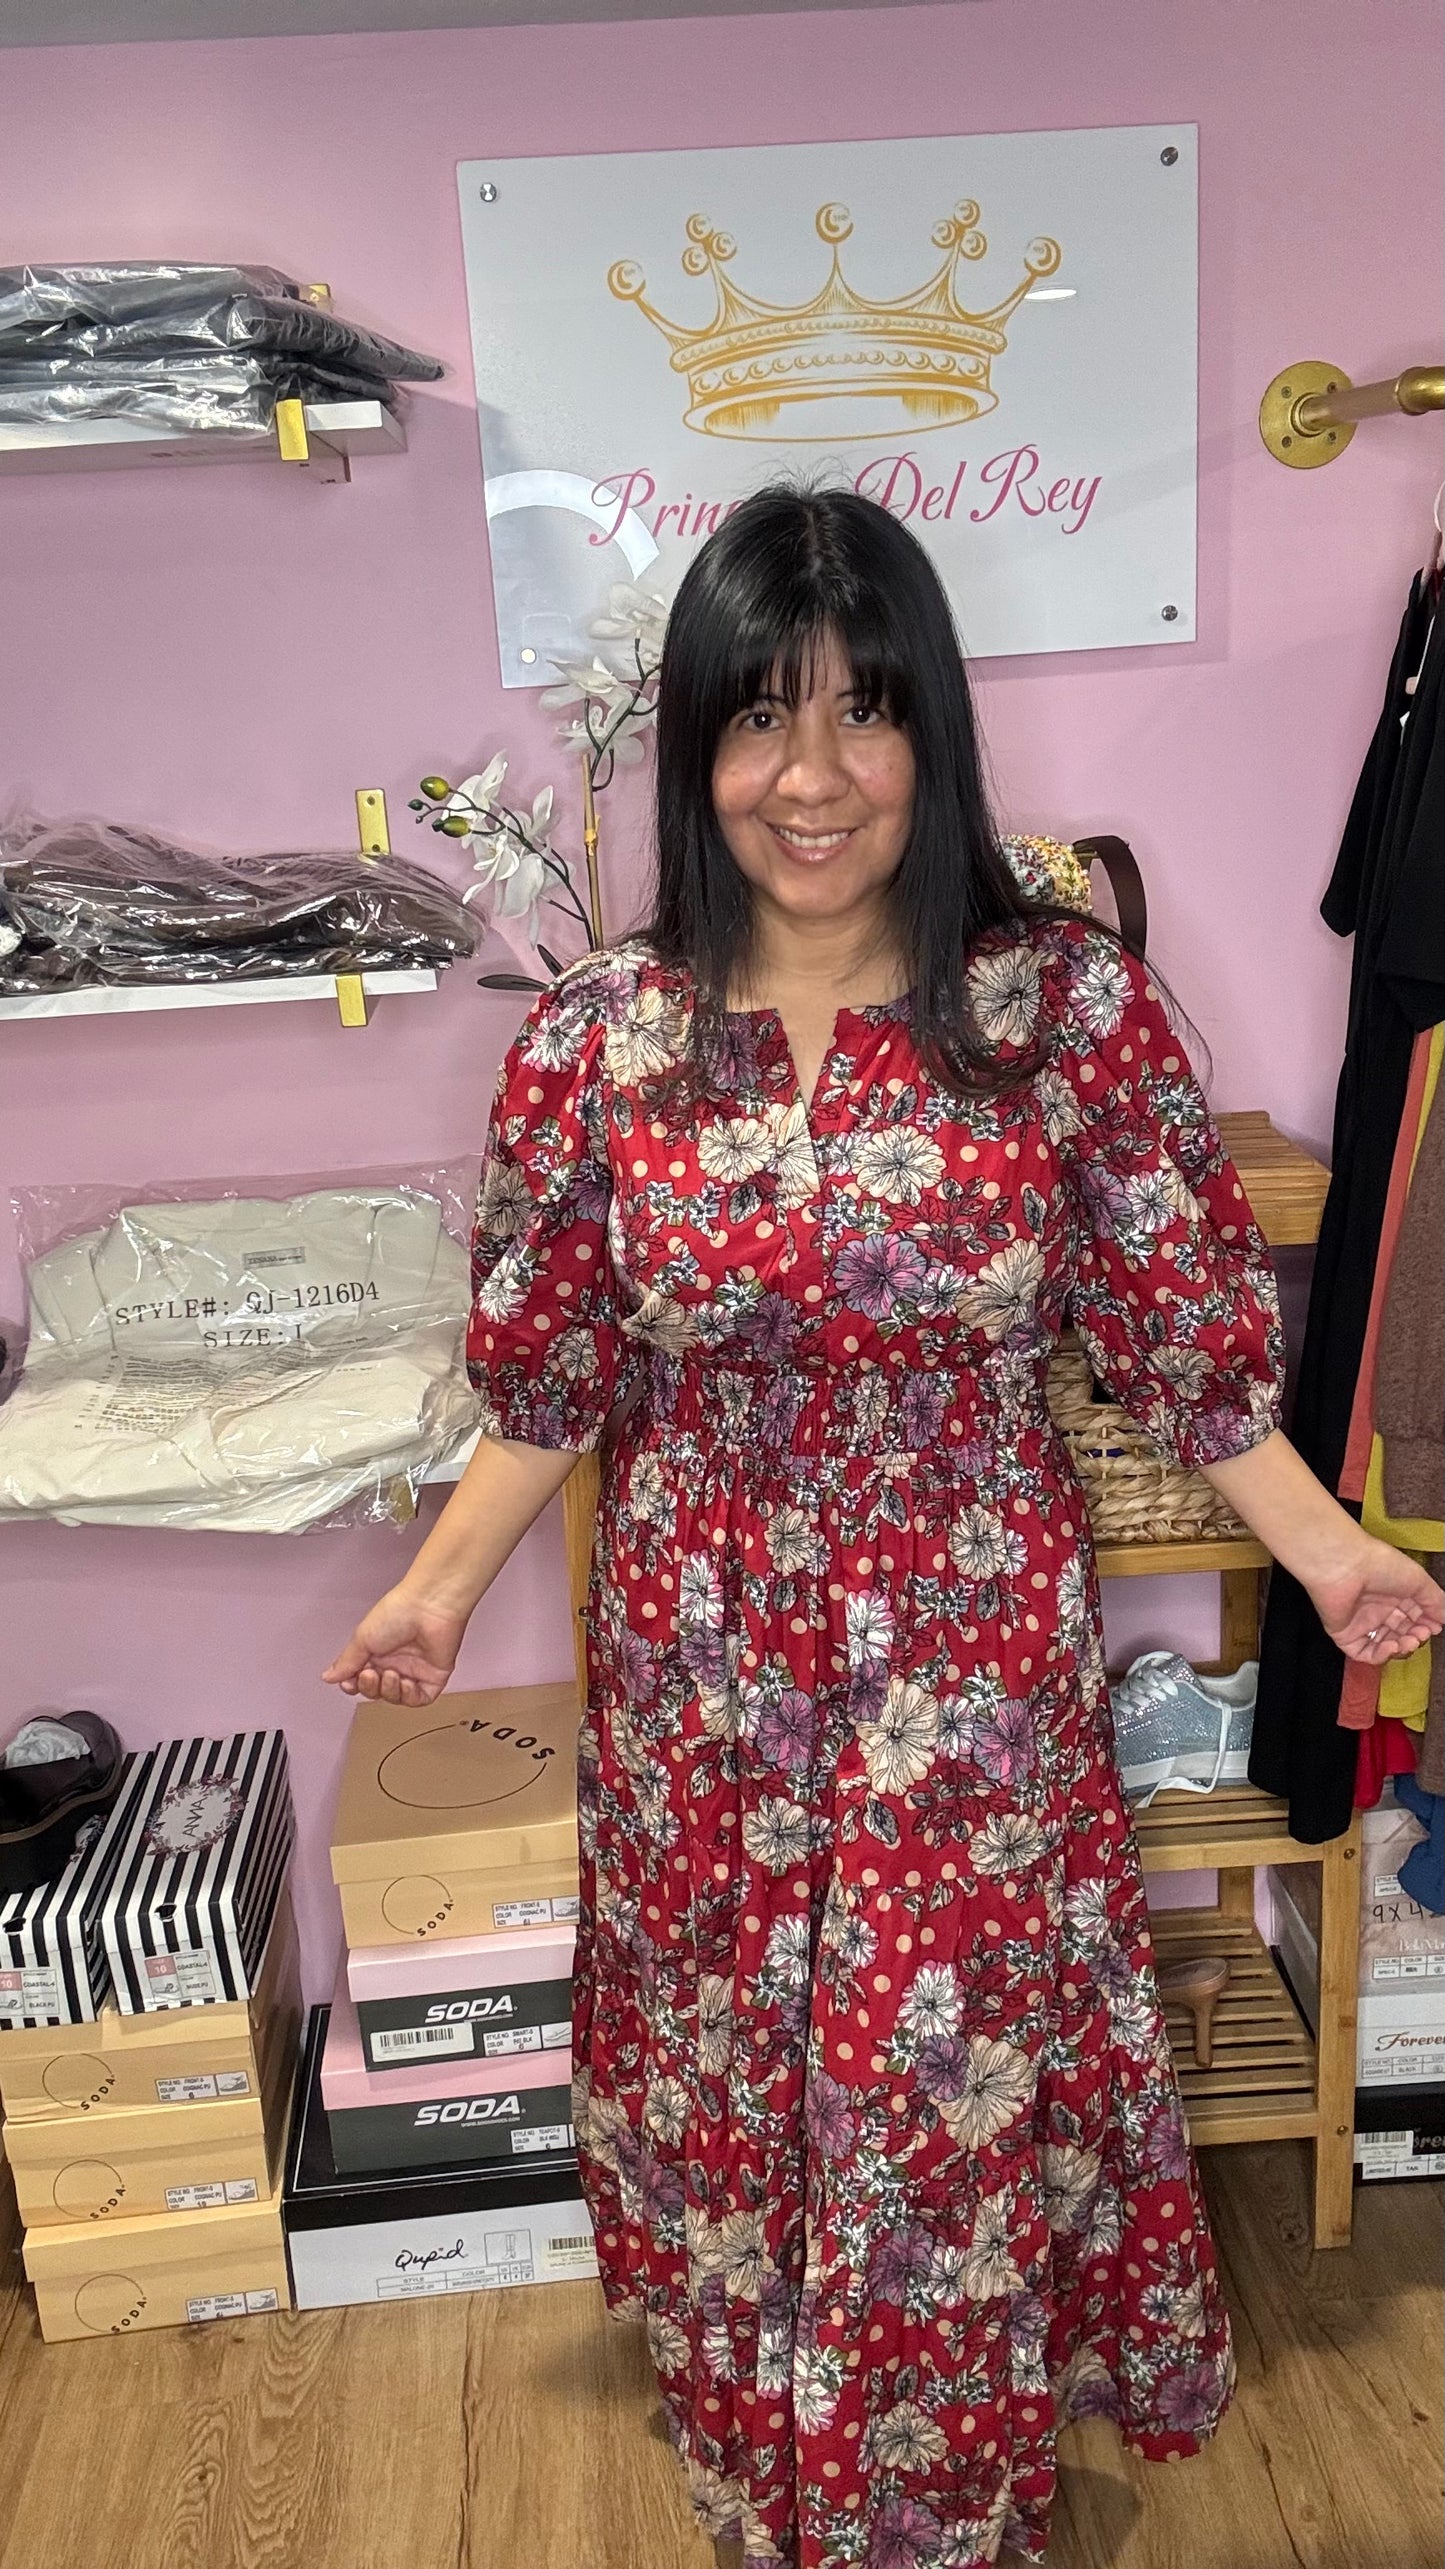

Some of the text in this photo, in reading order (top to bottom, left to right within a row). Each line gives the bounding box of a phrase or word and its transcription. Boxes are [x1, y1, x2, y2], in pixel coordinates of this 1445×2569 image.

[588, 444, 1103, 547] Prin Del Rey
[115, 1297, 230, 1326] STYLE#:
[470, 1719, 556, 1760] SODA
[416, 1901, 455, 1937] SODA
[425, 1995, 514, 2024] SODA
[80, 2078, 116, 2111] SODA
[414, 2095, 520, 2126] SODA
[90, 2188, 126, 2219] SODA
[395, 2239, 465, 2272] Qupid
[111, 2301, 147, 2334] SODA
